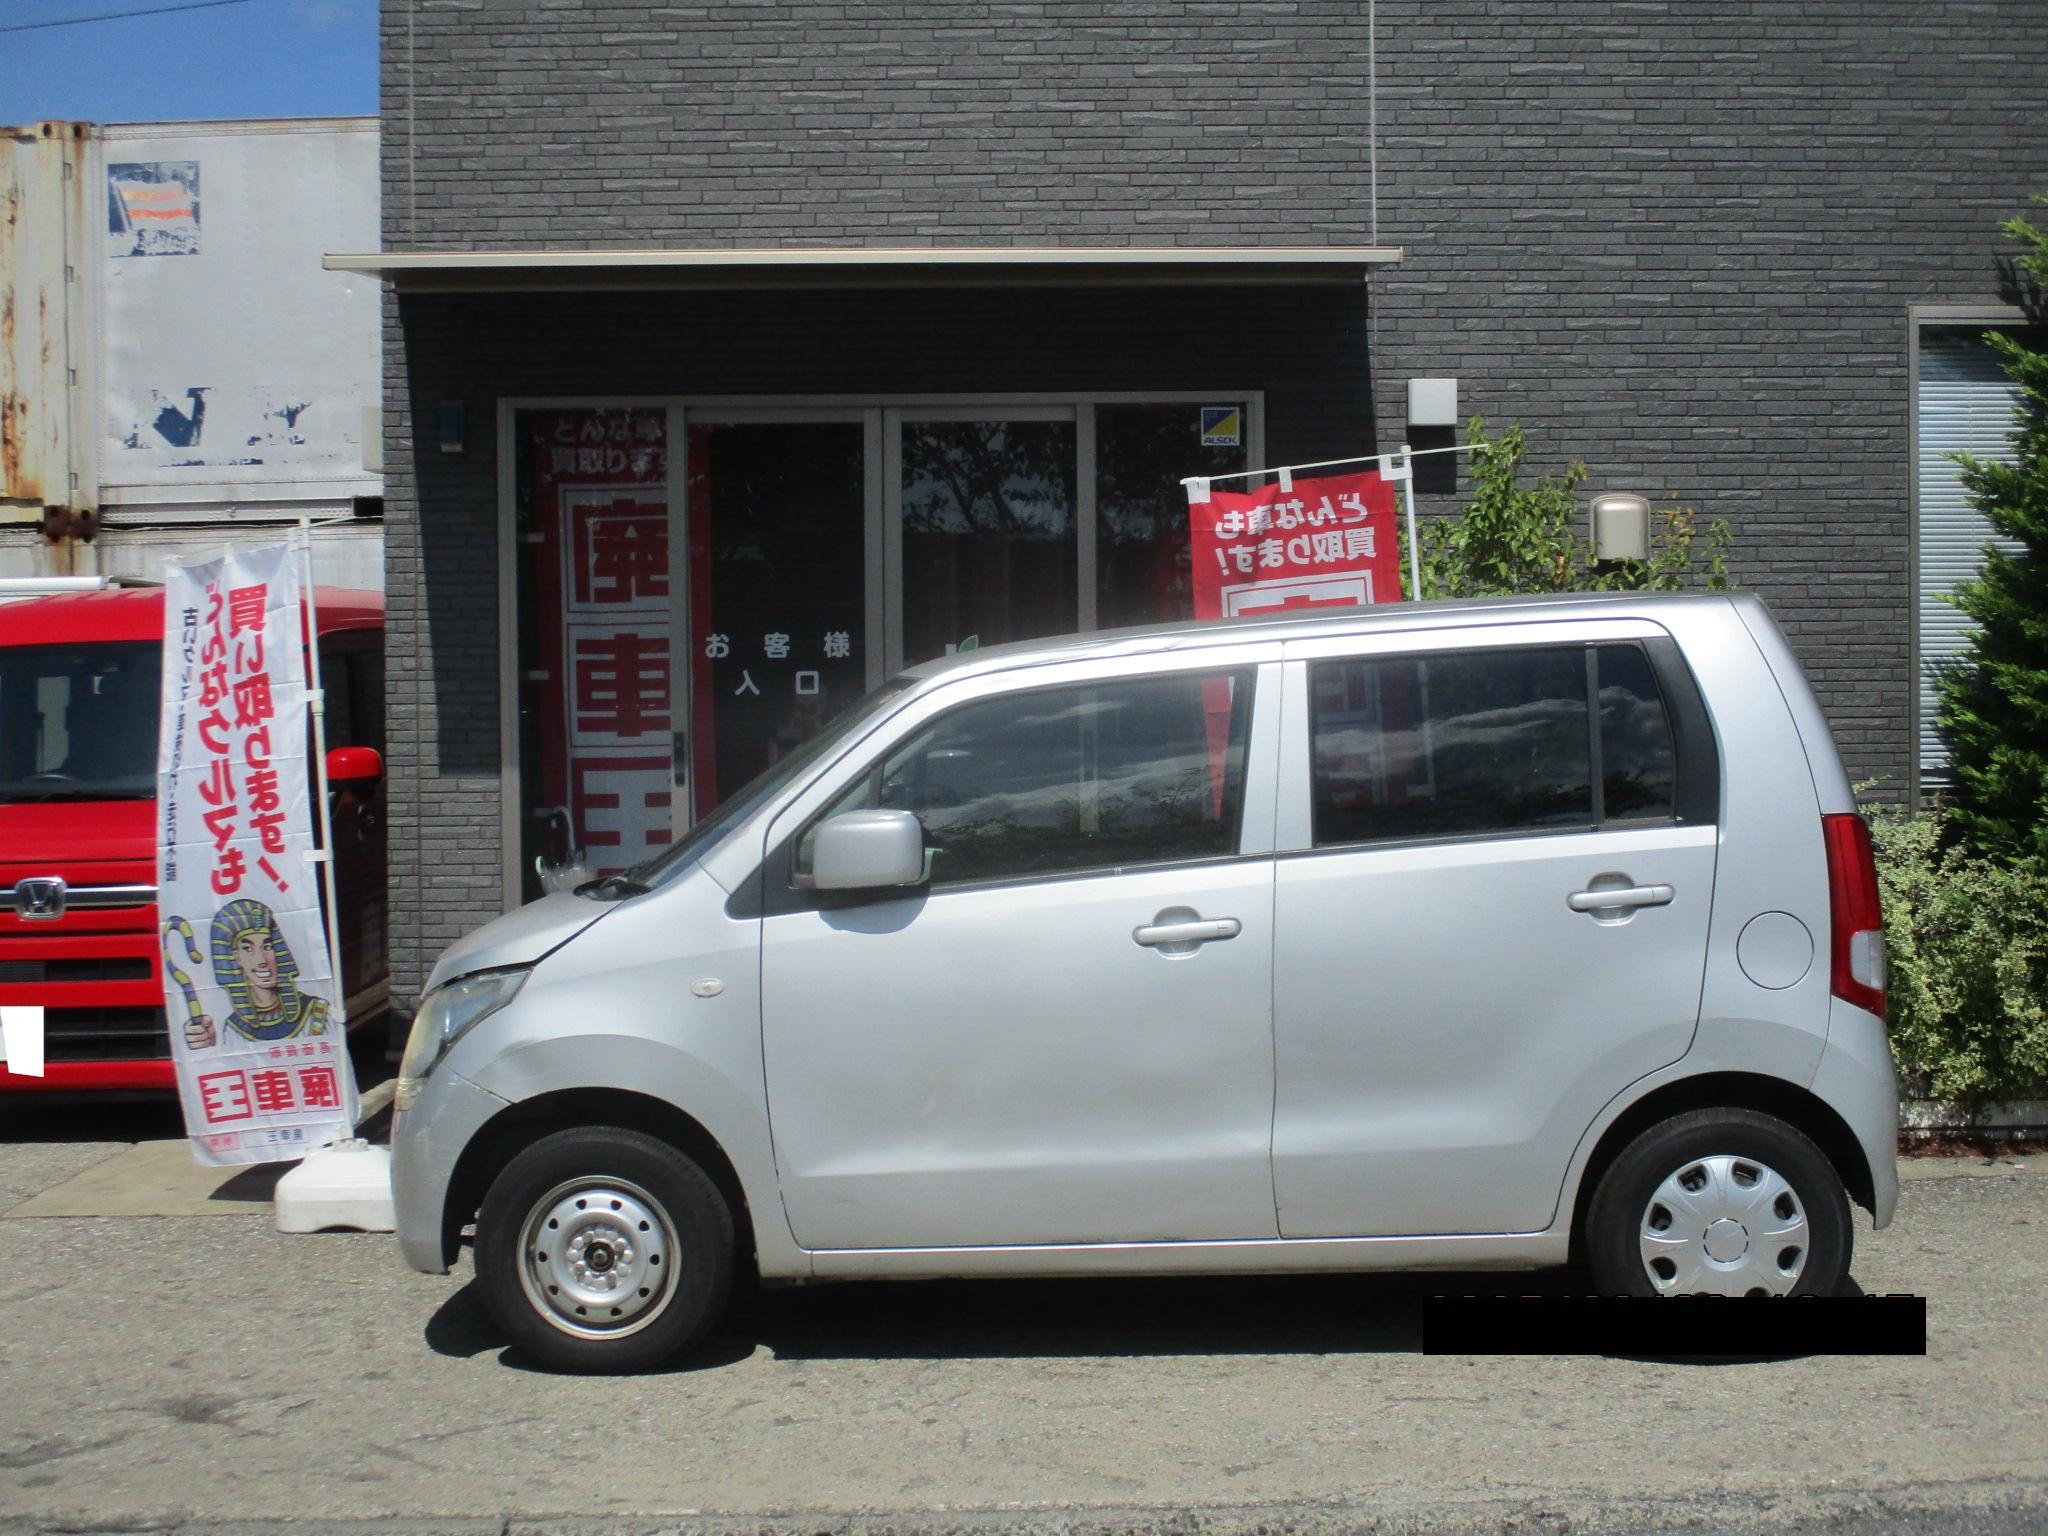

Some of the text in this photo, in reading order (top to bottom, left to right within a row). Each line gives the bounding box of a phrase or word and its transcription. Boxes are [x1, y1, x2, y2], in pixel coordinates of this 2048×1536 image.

[1204, 436, 1238, 444] ALSOK
[704, 631, 851, 660] お客様
[734, 669, 820, 696] 入口
